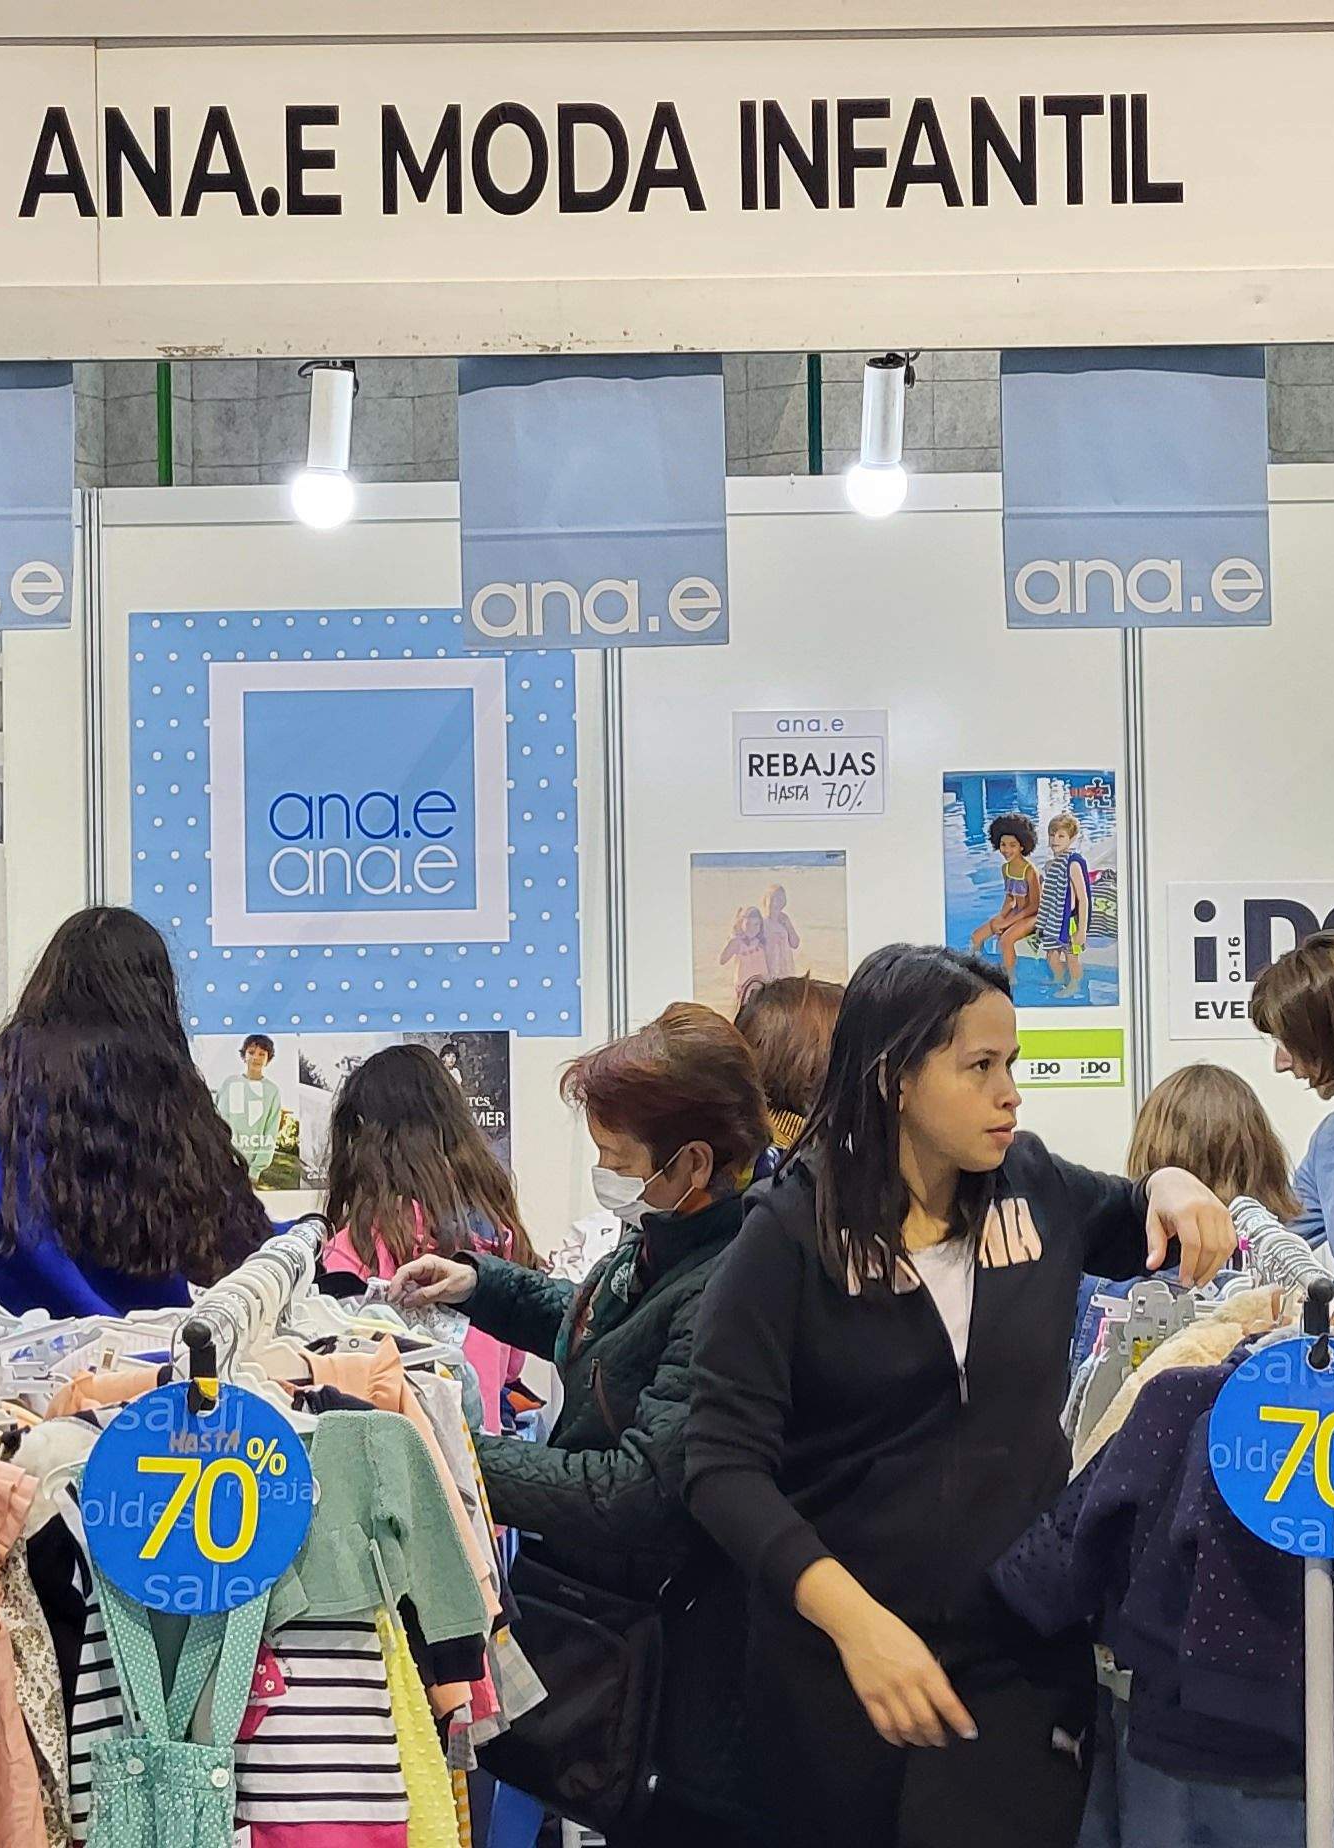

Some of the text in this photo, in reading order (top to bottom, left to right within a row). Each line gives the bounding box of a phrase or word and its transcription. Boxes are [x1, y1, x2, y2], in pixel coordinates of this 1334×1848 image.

[18, 93, 1184, 218] ANA.E MODA INFANTIL
[470, 576, 722, 638] ana.e
[1014, 557, 1264, 615] ana.e
[776, 718, 844, 733] ana.e
[748, 751, 876, 777] REBAJAS
[269, 789, 457, 841] ana.e
[768, 780, 866, 811] HASTA 70%
[269, 844, 458, 896] ana.e
[169, 1429, 241, 1453] HASTA
[137, 1437, 287, 1563] 70%
